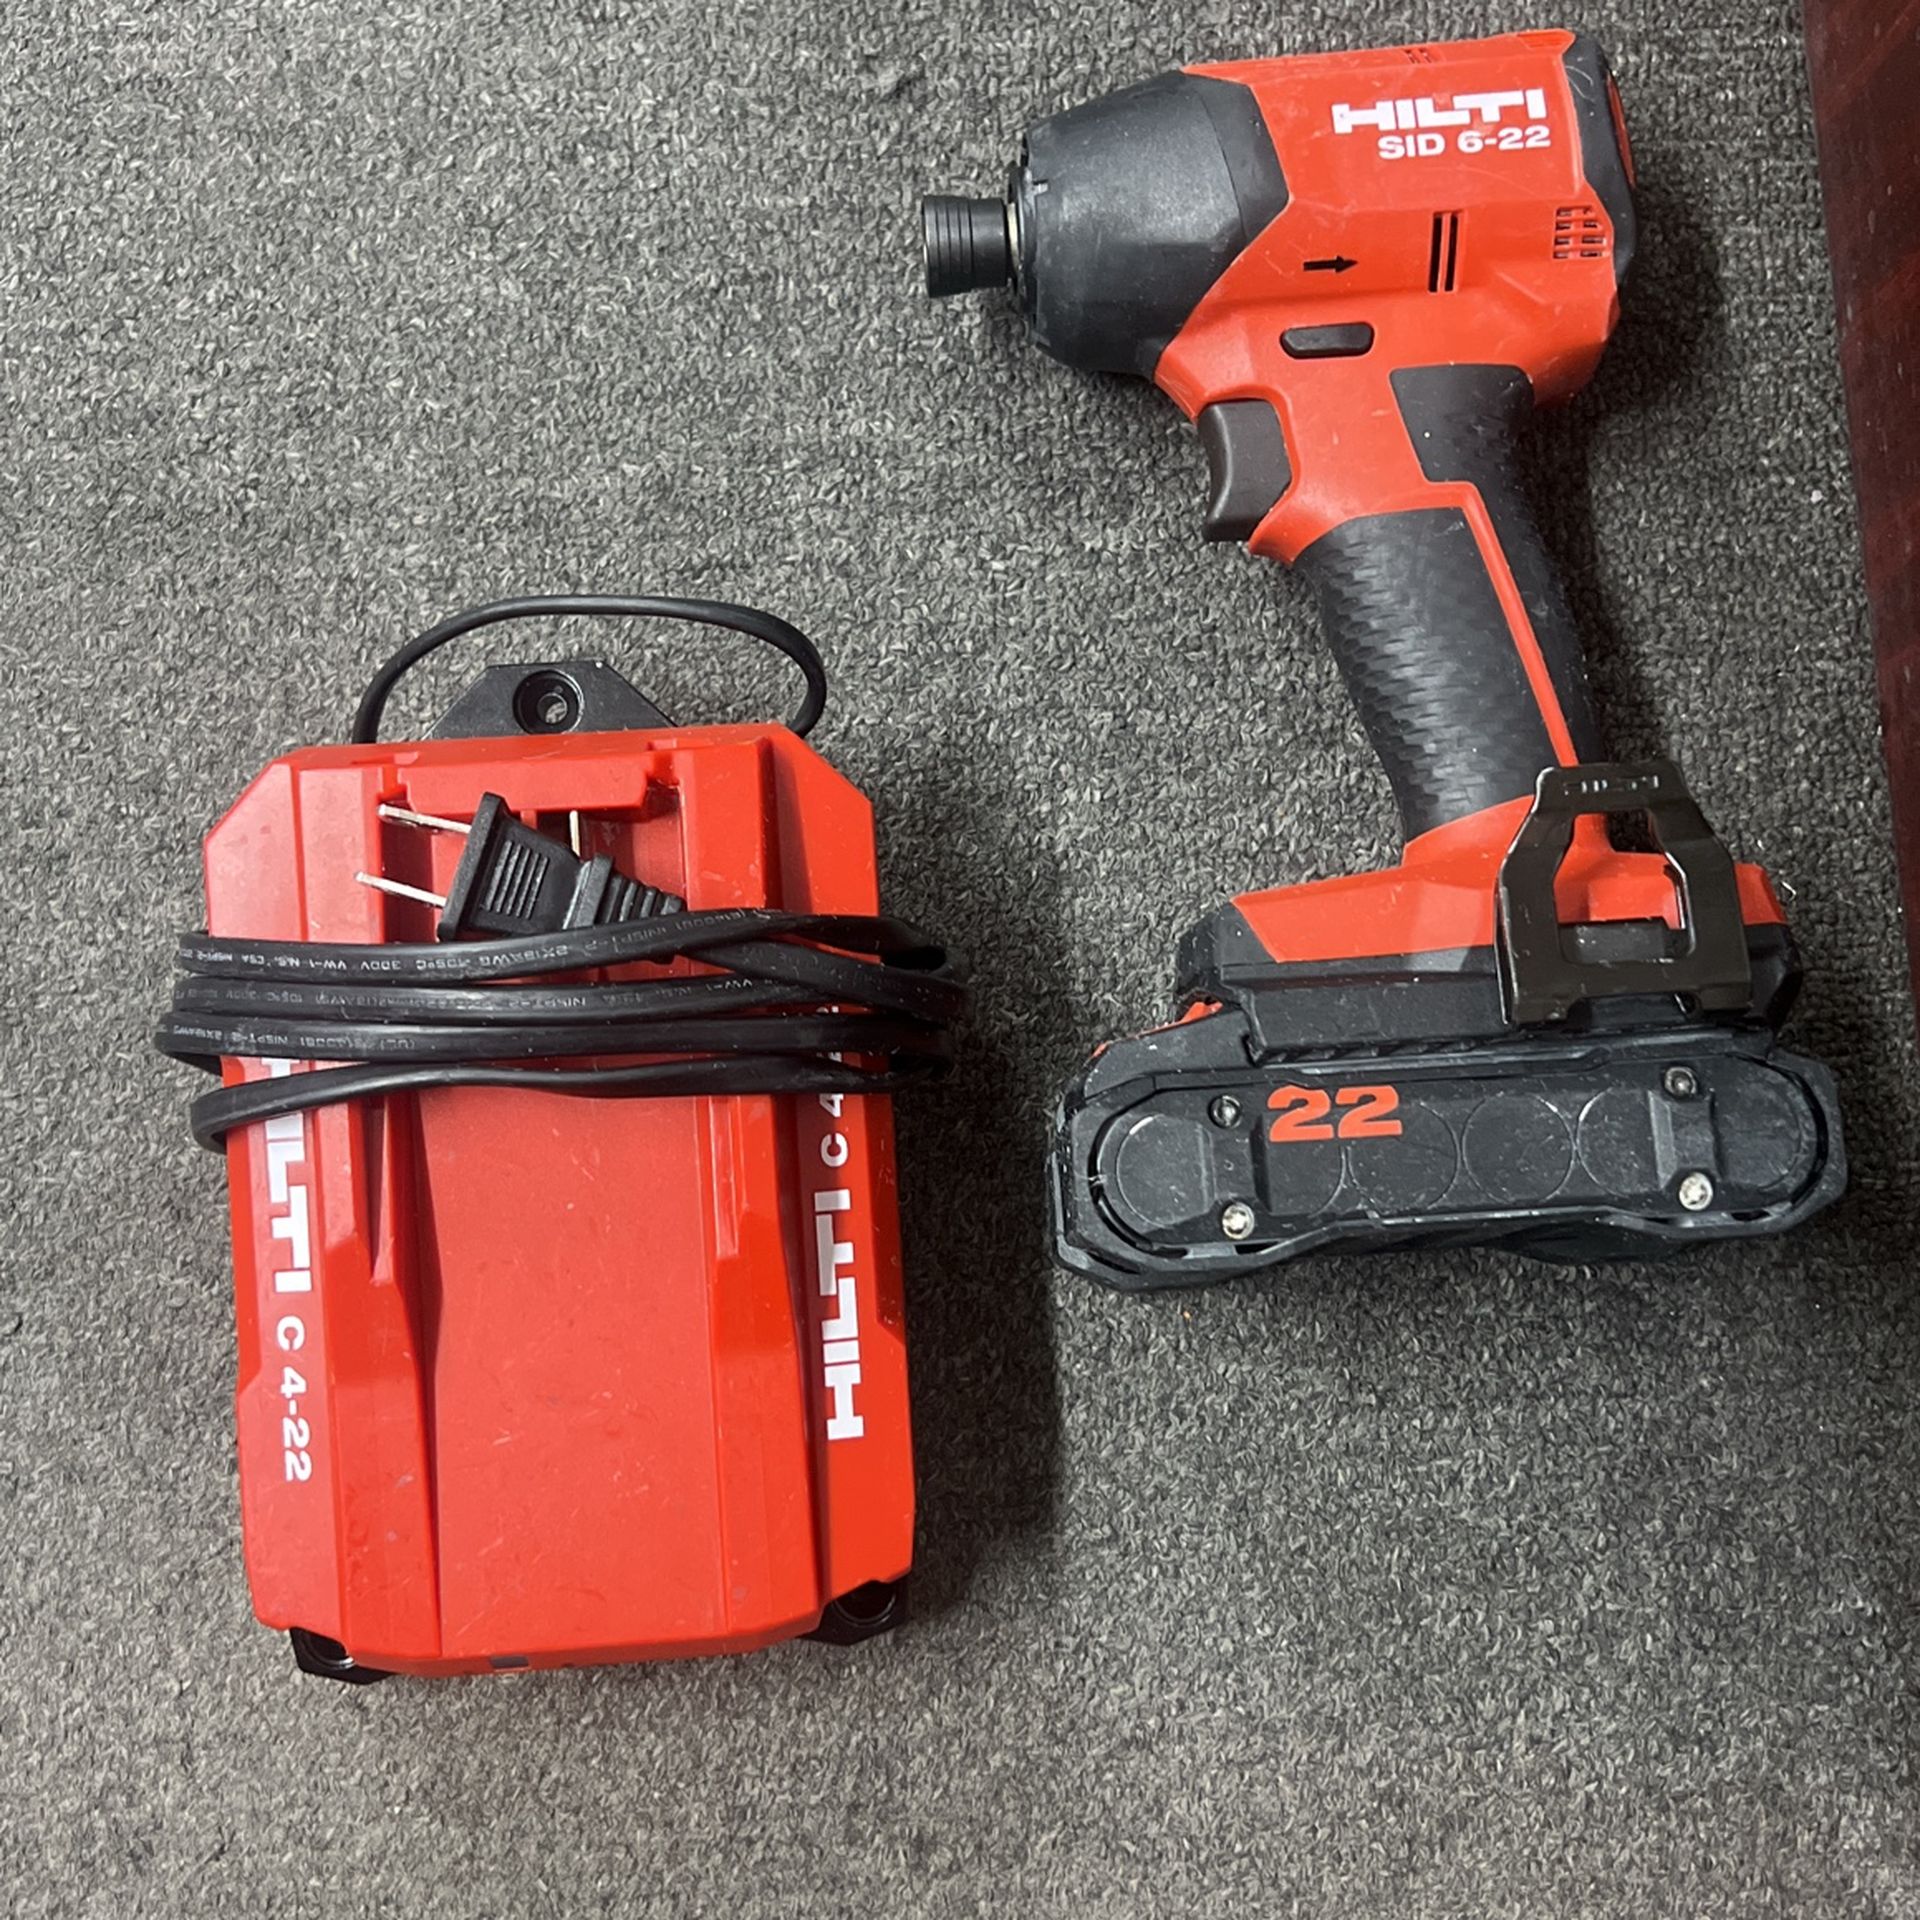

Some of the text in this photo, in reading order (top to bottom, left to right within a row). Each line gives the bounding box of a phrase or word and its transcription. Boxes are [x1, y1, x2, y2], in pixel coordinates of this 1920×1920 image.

[1331, 88, 1547, 134] HILTI
[1377, 125, 1551, 159] SID 6-22
[1267, 1085, 1402, 1142] 22
[820, 1131, 848, 1168] C
[276, 1315, 305, 1351] C
[814, 1189, 864, 1440] HILTI
[279, 1366, 313, 1481] 4-22
